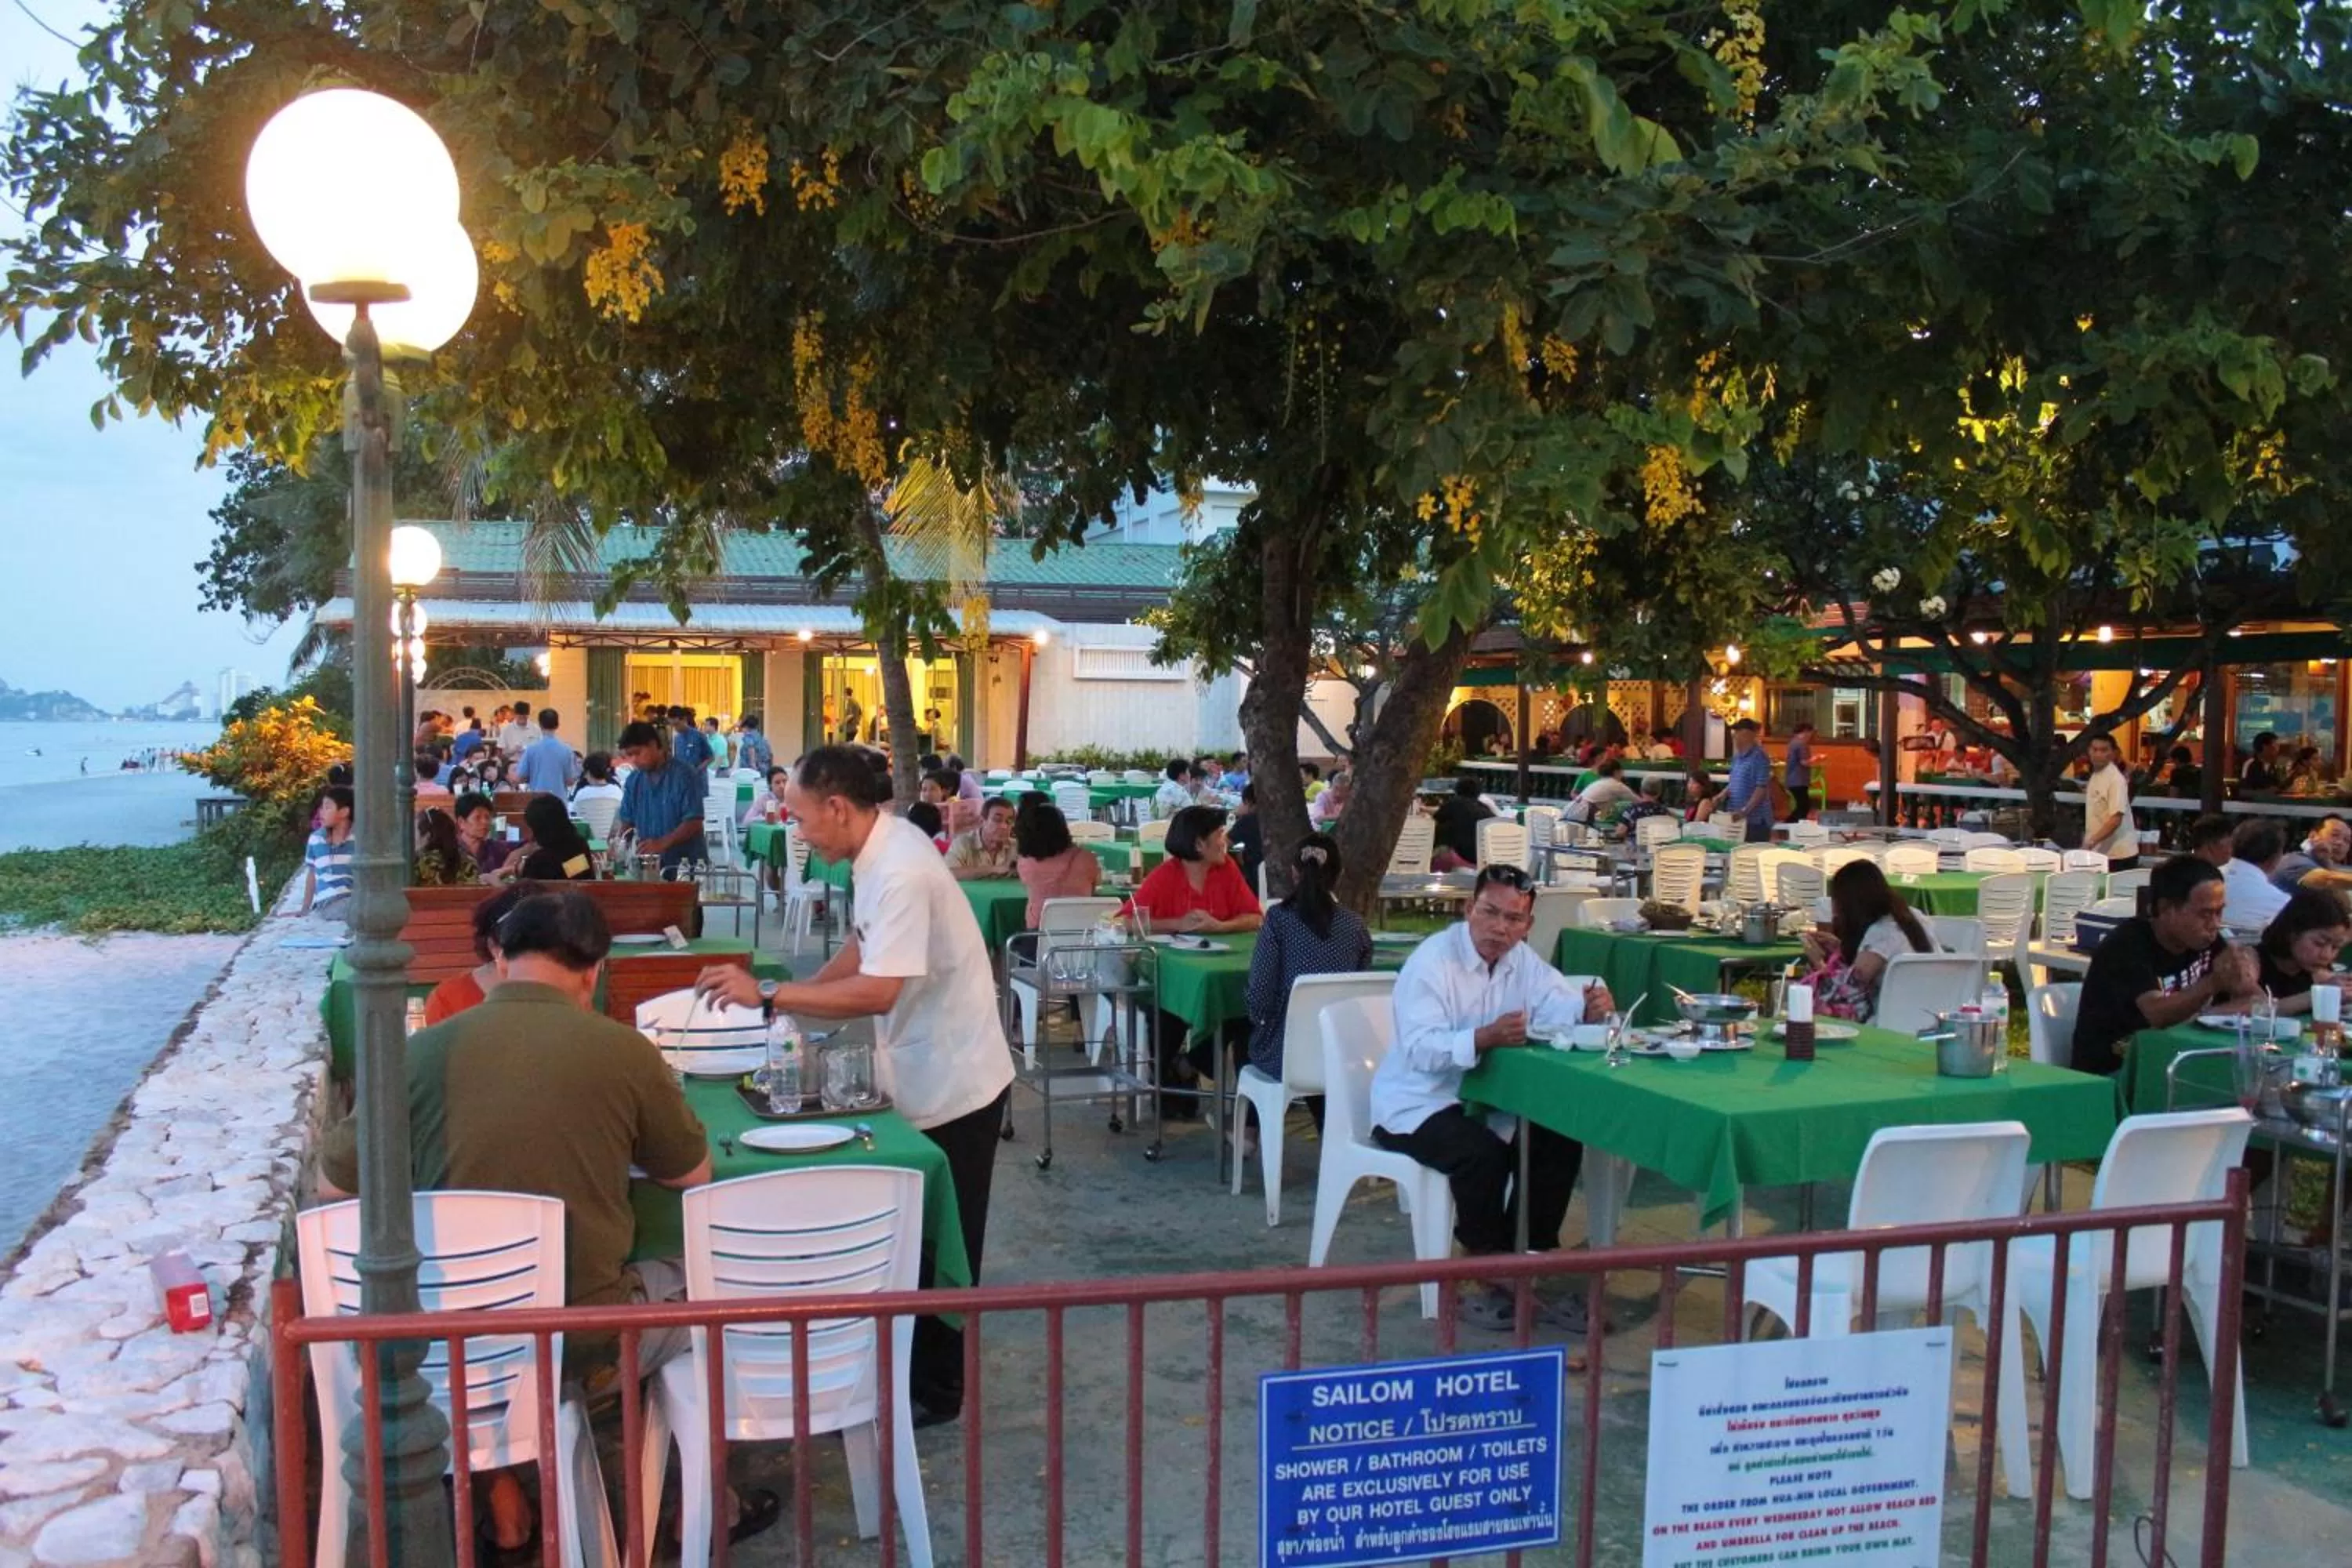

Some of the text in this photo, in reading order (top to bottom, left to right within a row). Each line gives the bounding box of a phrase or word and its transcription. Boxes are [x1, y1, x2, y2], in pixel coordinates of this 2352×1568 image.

[1312, 1370, 1520, 1407] SAILOM HOTEL
[1308, 1418, 1396, 1443] NOTICE
[1420, 1407, 1523, 1435] โปรดทราบ
[1275, 1457, 1349, 1480] SHOWER
[1368, 1446, 1463, 1471] BATHROOM
[1482, 1436, 1548, 1457] TOILETS
[1301, 1461, 1530, 1502] ARE EXCLUSIVELY FOR USE
[1769, 1470, 1832, 1486] PLEASE NOTE
[1298, 1485, 1533, 1526] BY OUR HOTEL GUEST ONLY
[1653, 1526, 1667, 1535] ON
[1672, 1524, 1689, 1534] THE
[1693, 1520, 1725, 1531] BEACH
[1728, 1517, 1758, 1529] EVERY
[1763, 1510, 1821, 1524] WEDNESDAY
[1826, 1507, 1846, 1517] NOT
[1849, 1503, 1882, 1515] ALLOW
[1886, 1499, 1915, 1511] BEACH
[1682, 1504, 1699, 1513] THE
[1704, 1501, 1736, 1512] ORDER
[1740, 1497, 1767, 1508] FROM
[1818, 1487, 1846, 1500] LOCAL
[1696, 1541, 1717, 1551] AND
[1722, 1535, 1771, 1548] UMBRELLA
[1776, 1532, 1795, 1542] FOR
[1798, 1529, 1828, 1541] CLEAN
[1832, 1526, 1844, 1536] UP
[1848, 1524, 1864, 1533] THE
[1696, 1559, 1712, 1568] THE
[1718, 1553, 1774, 1567] CUSTOMERS
[1778, 1548, 1798, 1559] CAN
[1835, 1543, 1862, 1554] YOUR
[1865, 1540, 1888, 1549] OWN
